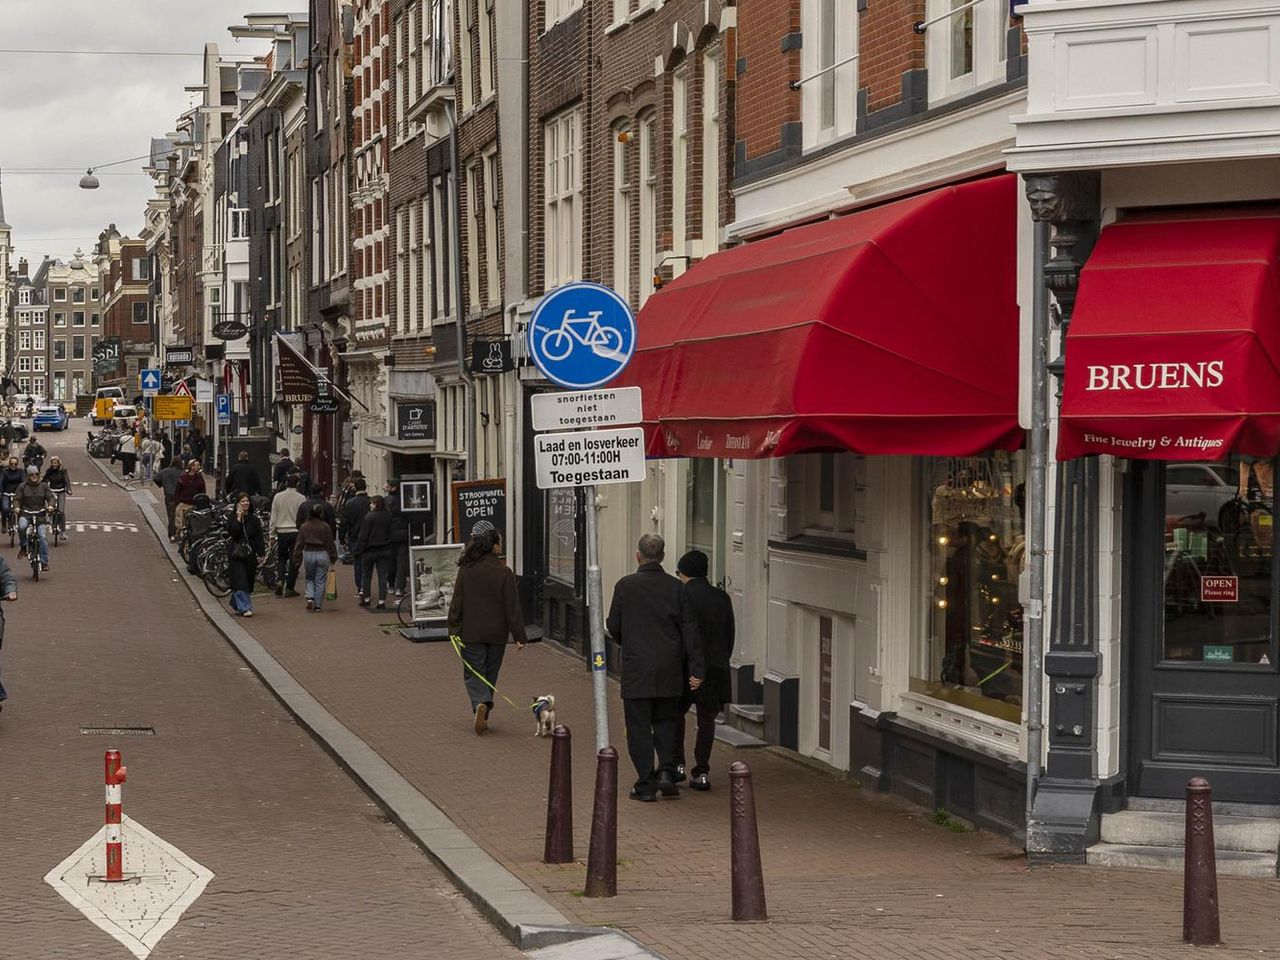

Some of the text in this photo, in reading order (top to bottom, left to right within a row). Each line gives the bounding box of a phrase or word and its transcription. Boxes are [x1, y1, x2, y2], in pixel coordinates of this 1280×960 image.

[1085, 360, 1224, 390] BRUENS
[219, 397, 227, 410] P
[557, 392, 616, 403] snorfietsen
[577, 404, 597, 413] niet
[559, 414, 616, 425] toegestaan
[539, 436, 640, 453] Laad en losverkeer
[1084, 434, 1224, 451] Fine Jewelry & Antiques
[552, 451, 621, 466] 07:00-11:00H
[550, 468, 629, 484] Toegestaan
[464, 498, 497, 507] WORLD
[465, 506, 494, 518] OPEN
[1206, 579, 1233, 588] OPEN
